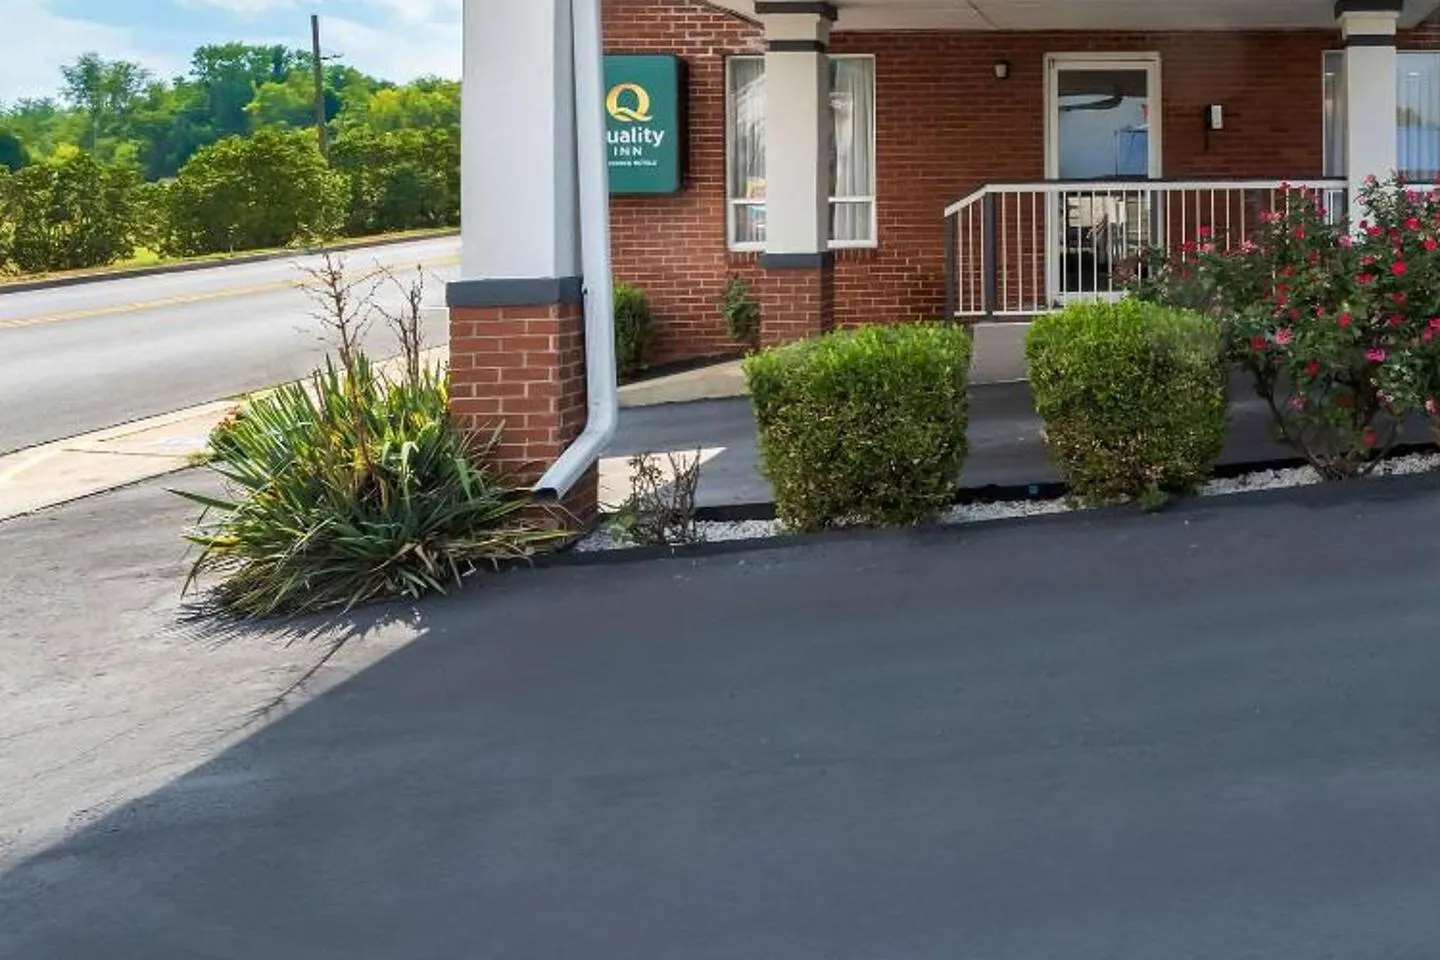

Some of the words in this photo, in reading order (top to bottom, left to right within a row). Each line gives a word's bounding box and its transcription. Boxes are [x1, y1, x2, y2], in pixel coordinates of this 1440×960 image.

[606, 83, 653, 122] Q
[607, 126, 665, 147] uality
[613, 146, 642, 156] INN
